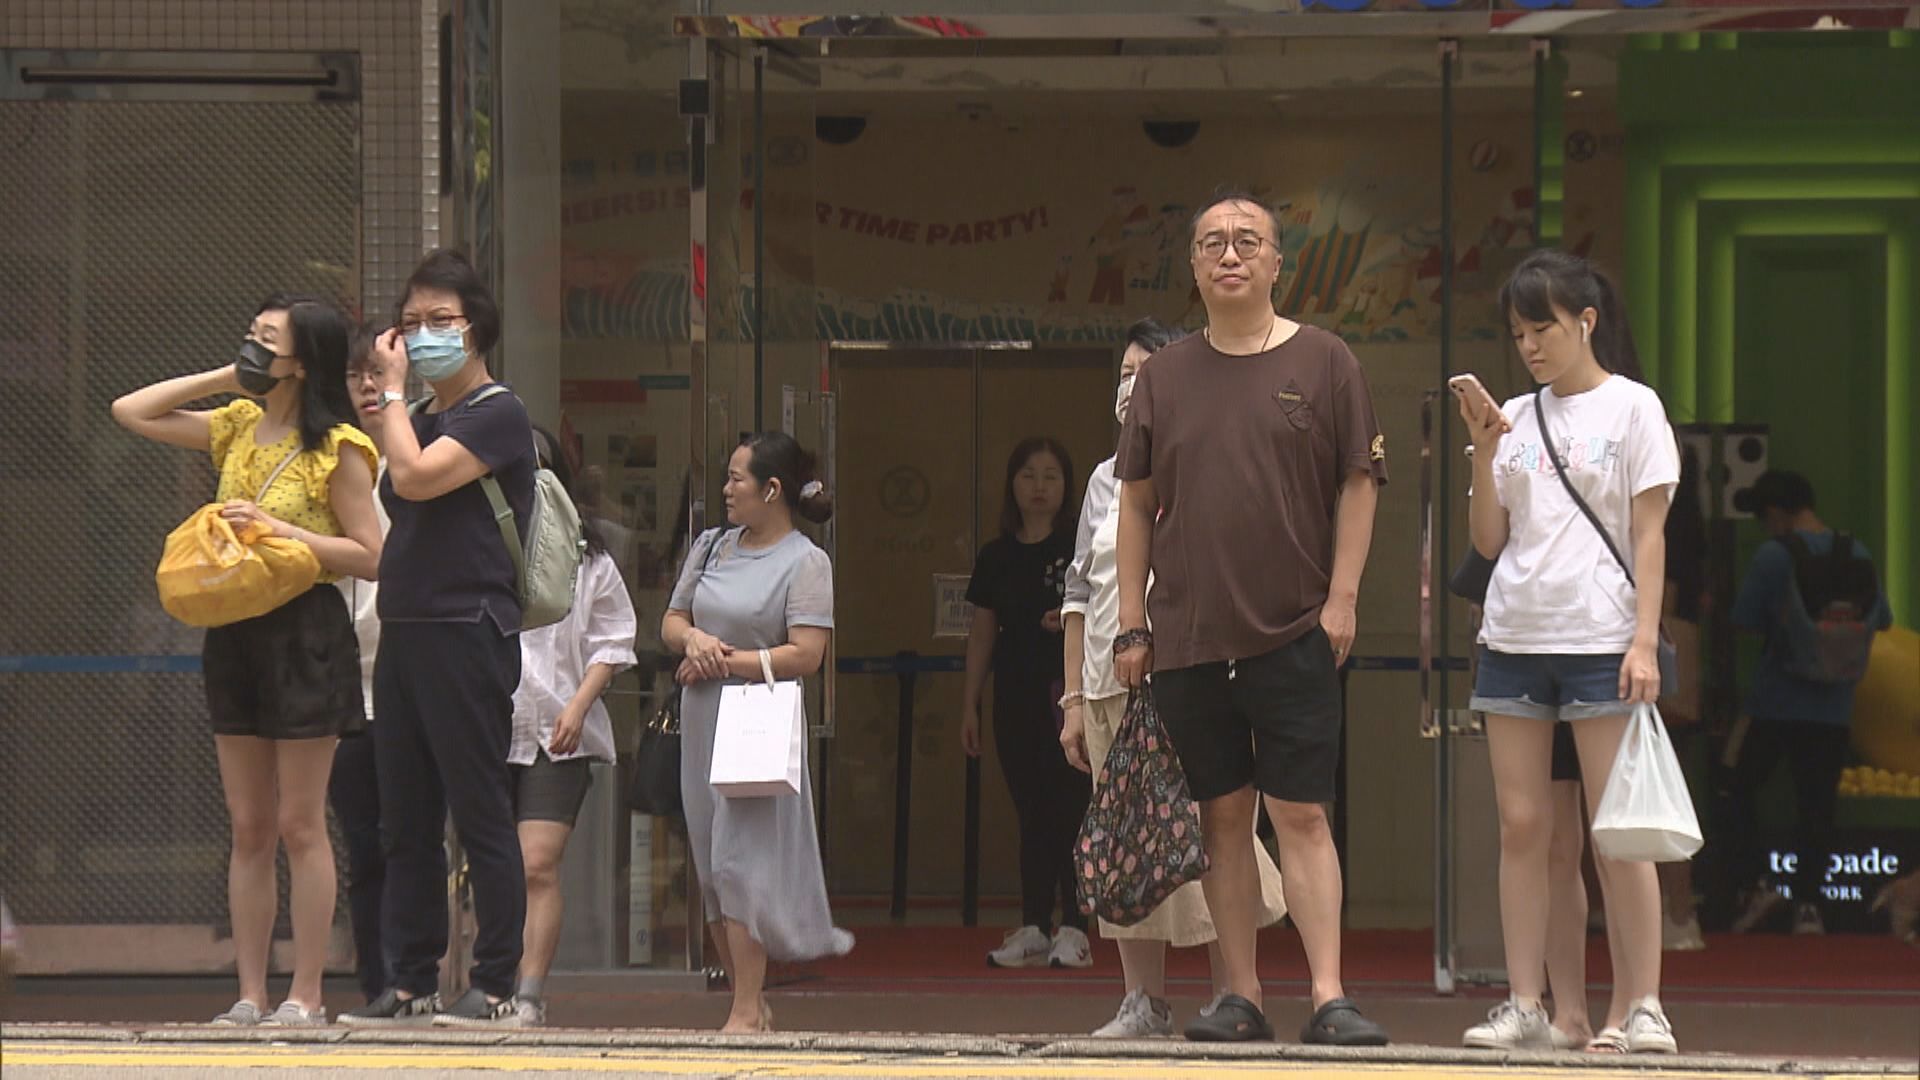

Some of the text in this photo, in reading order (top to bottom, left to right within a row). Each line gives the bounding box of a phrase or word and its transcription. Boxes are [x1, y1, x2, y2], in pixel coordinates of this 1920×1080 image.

[839, 206, 920, 244] TIME
[925, 204, 1049, 247] PARTY!
[1769, 847, 1900, 882] te pade
